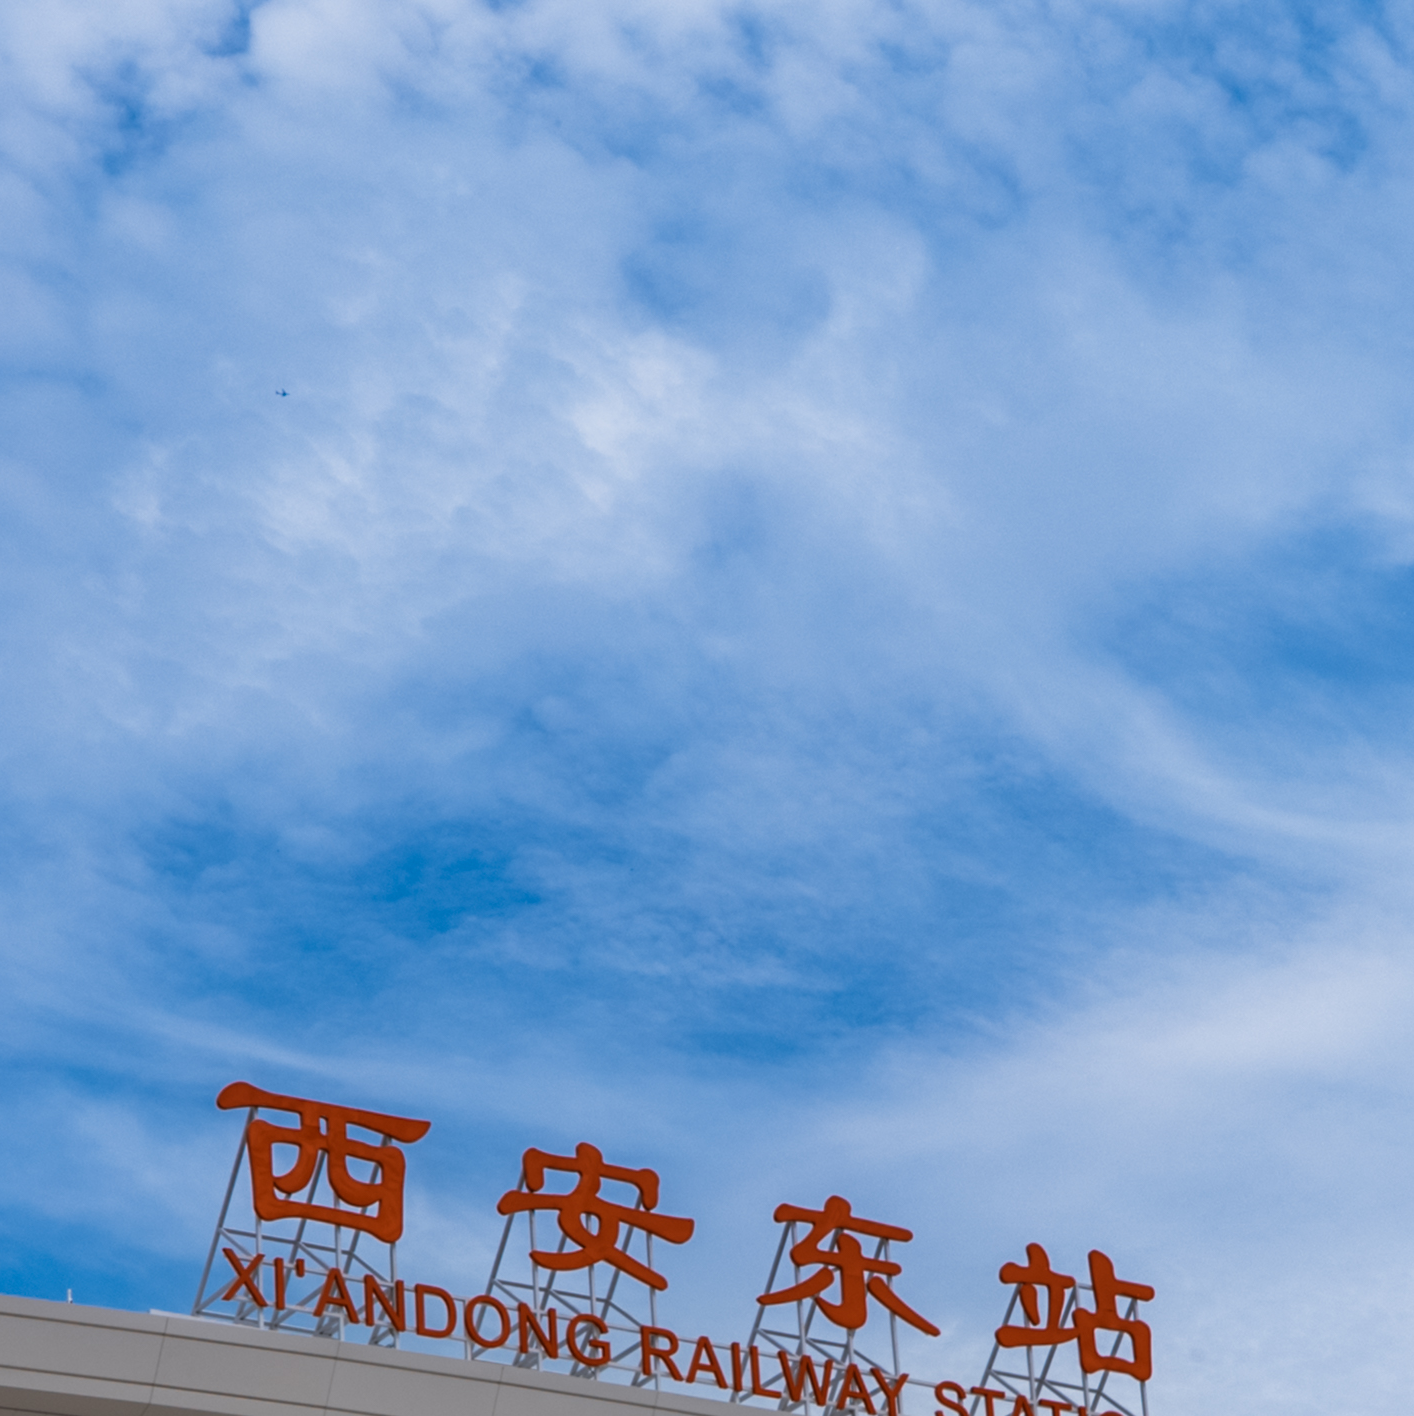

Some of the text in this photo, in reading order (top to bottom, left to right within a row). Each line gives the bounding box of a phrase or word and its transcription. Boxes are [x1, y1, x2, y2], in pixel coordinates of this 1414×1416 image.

[217, 1081, 1155, 1383] 西安东站
[222, 1248, 611, 1368] XI'ANDONG
